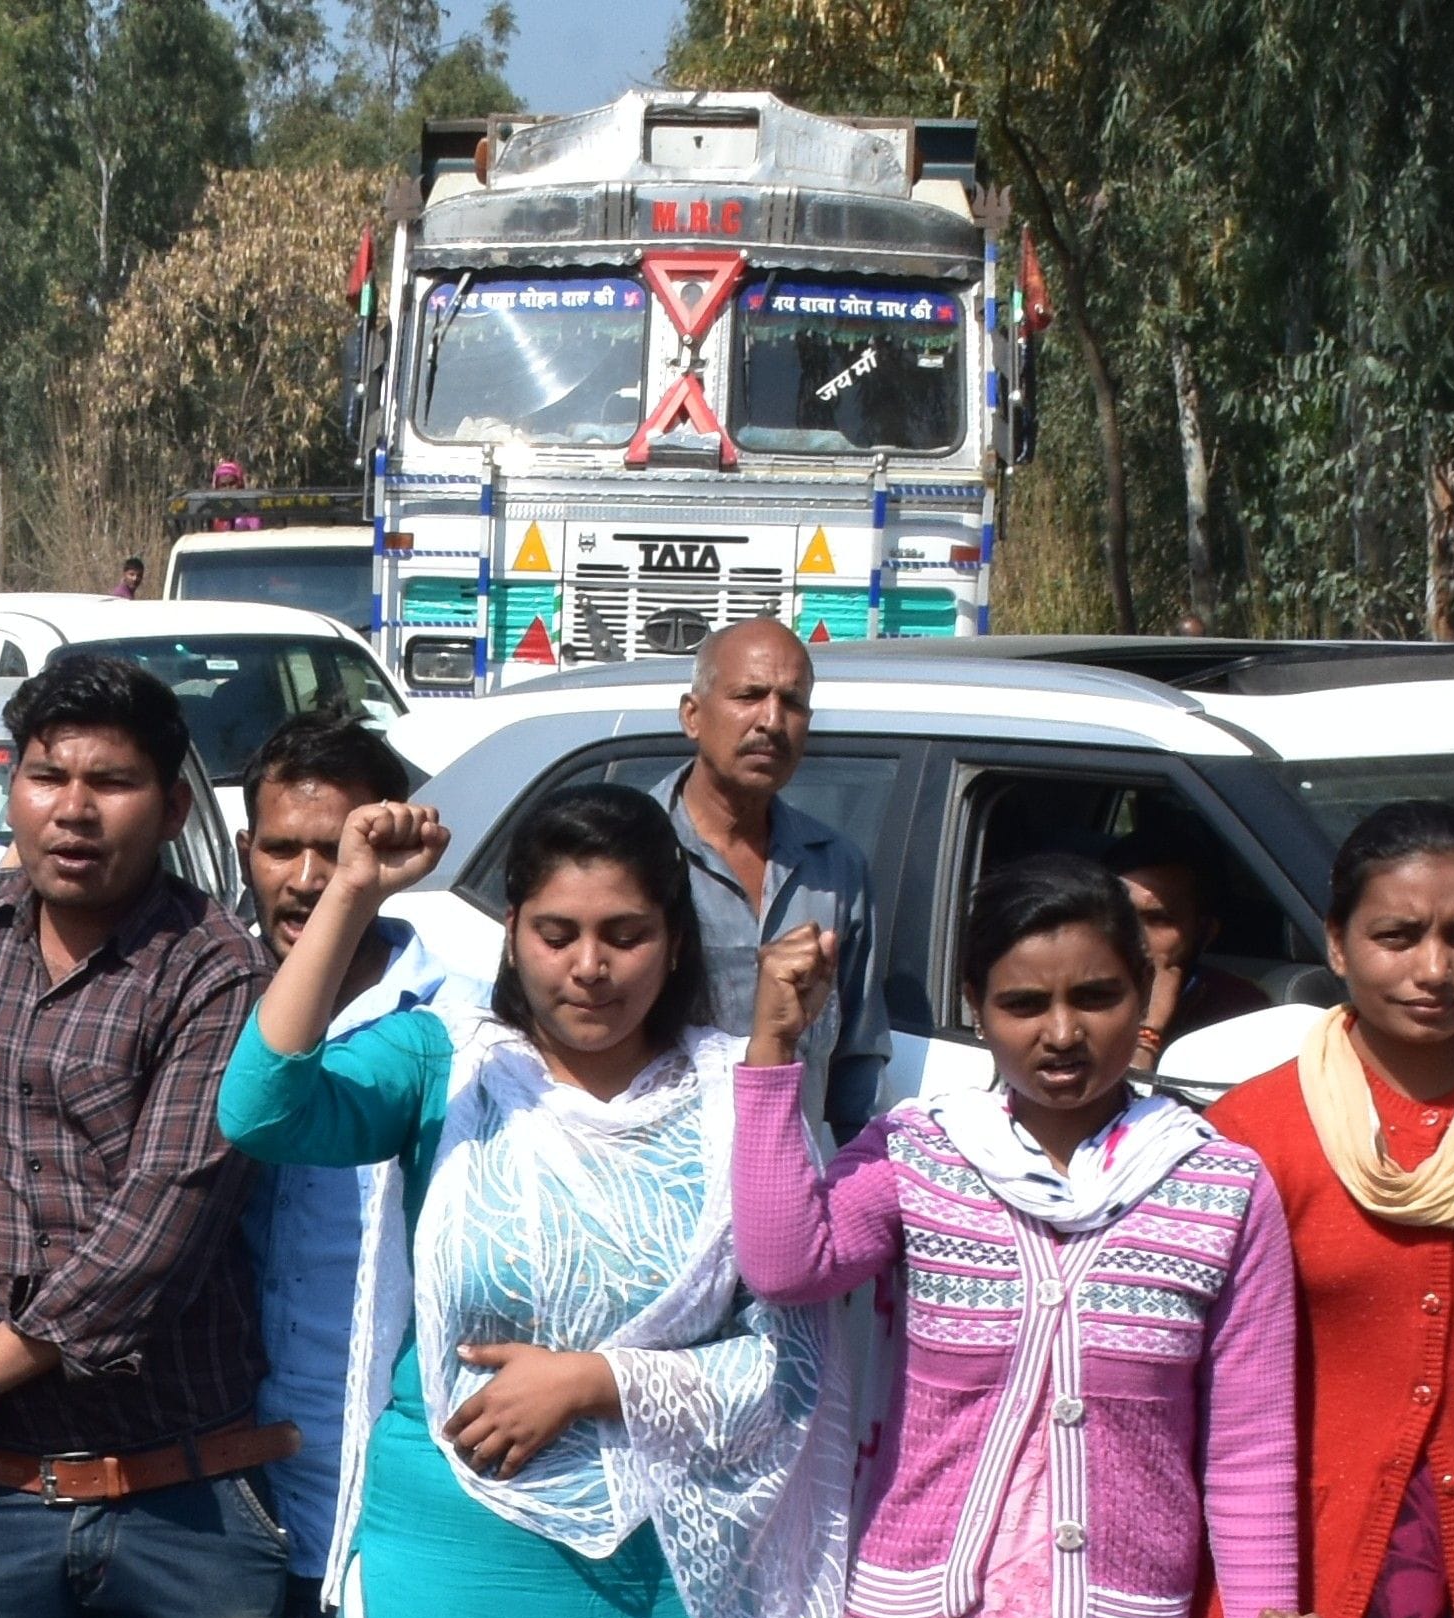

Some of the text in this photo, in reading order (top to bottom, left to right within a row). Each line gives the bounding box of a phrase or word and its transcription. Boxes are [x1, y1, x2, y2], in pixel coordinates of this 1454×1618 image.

[652, 200, 743, 235] M.R.C
[799, 297, 836, 313] बाबा
[910, 298, 933, 320] की
[815, 368, 853, 402] जय
[638, 543, 722, 570] TATA
